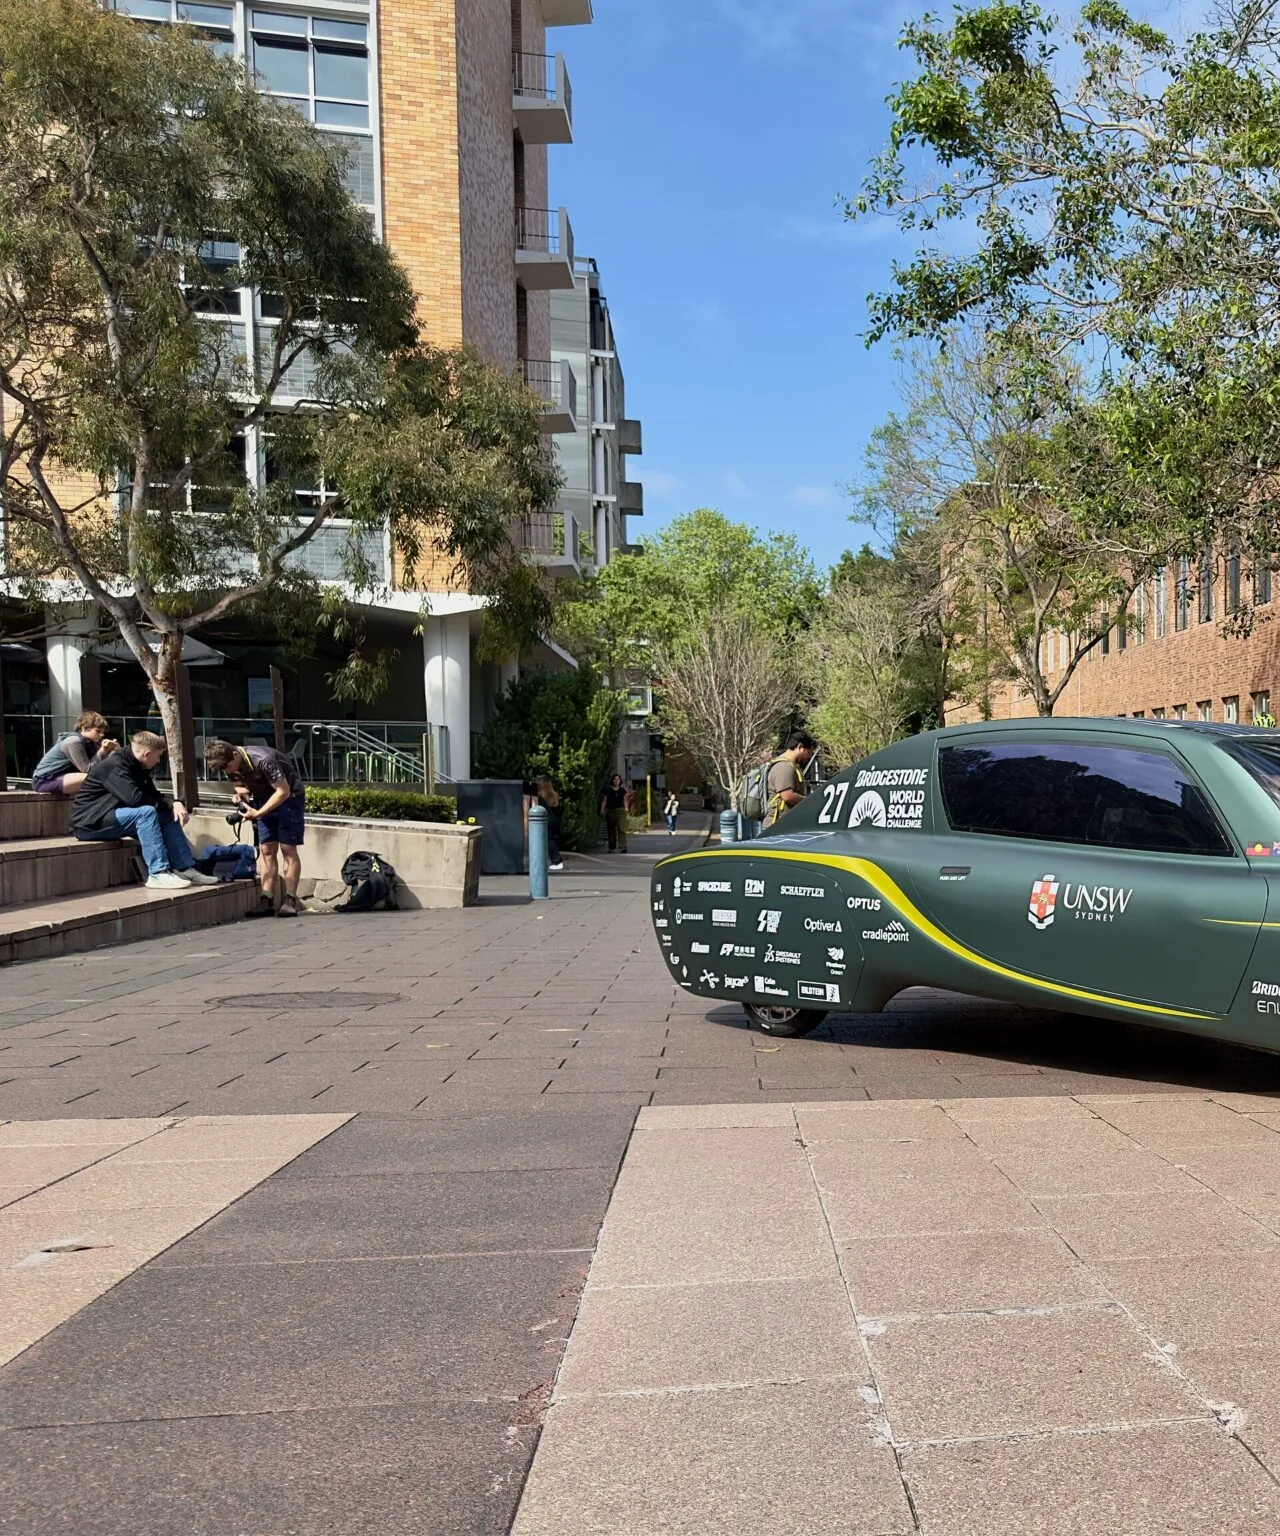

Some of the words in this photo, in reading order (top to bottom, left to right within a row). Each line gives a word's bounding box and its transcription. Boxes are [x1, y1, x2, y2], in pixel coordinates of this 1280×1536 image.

[854, 765, 929, 788] BRIDGESTONE
[818, 781, 850, 824] 27
[889, 790, 925, 804] WORLD
[887, 804, 923, 819] SOLAR
[887, 819, 922, 829] CHALLENGE
[780, 885, 825, 897] SCHAEFFLER
[847, 897, 881, 911] OPTUS
[1063, 883, 1133, 914] UNSW
[1075, 911, 1115, 922] SYDNEY
[804, 917, 835, 933] Optiver
[862, 928, 910, 943] cradlepoint
[801, 985, 825, 996] BILSTEIN
